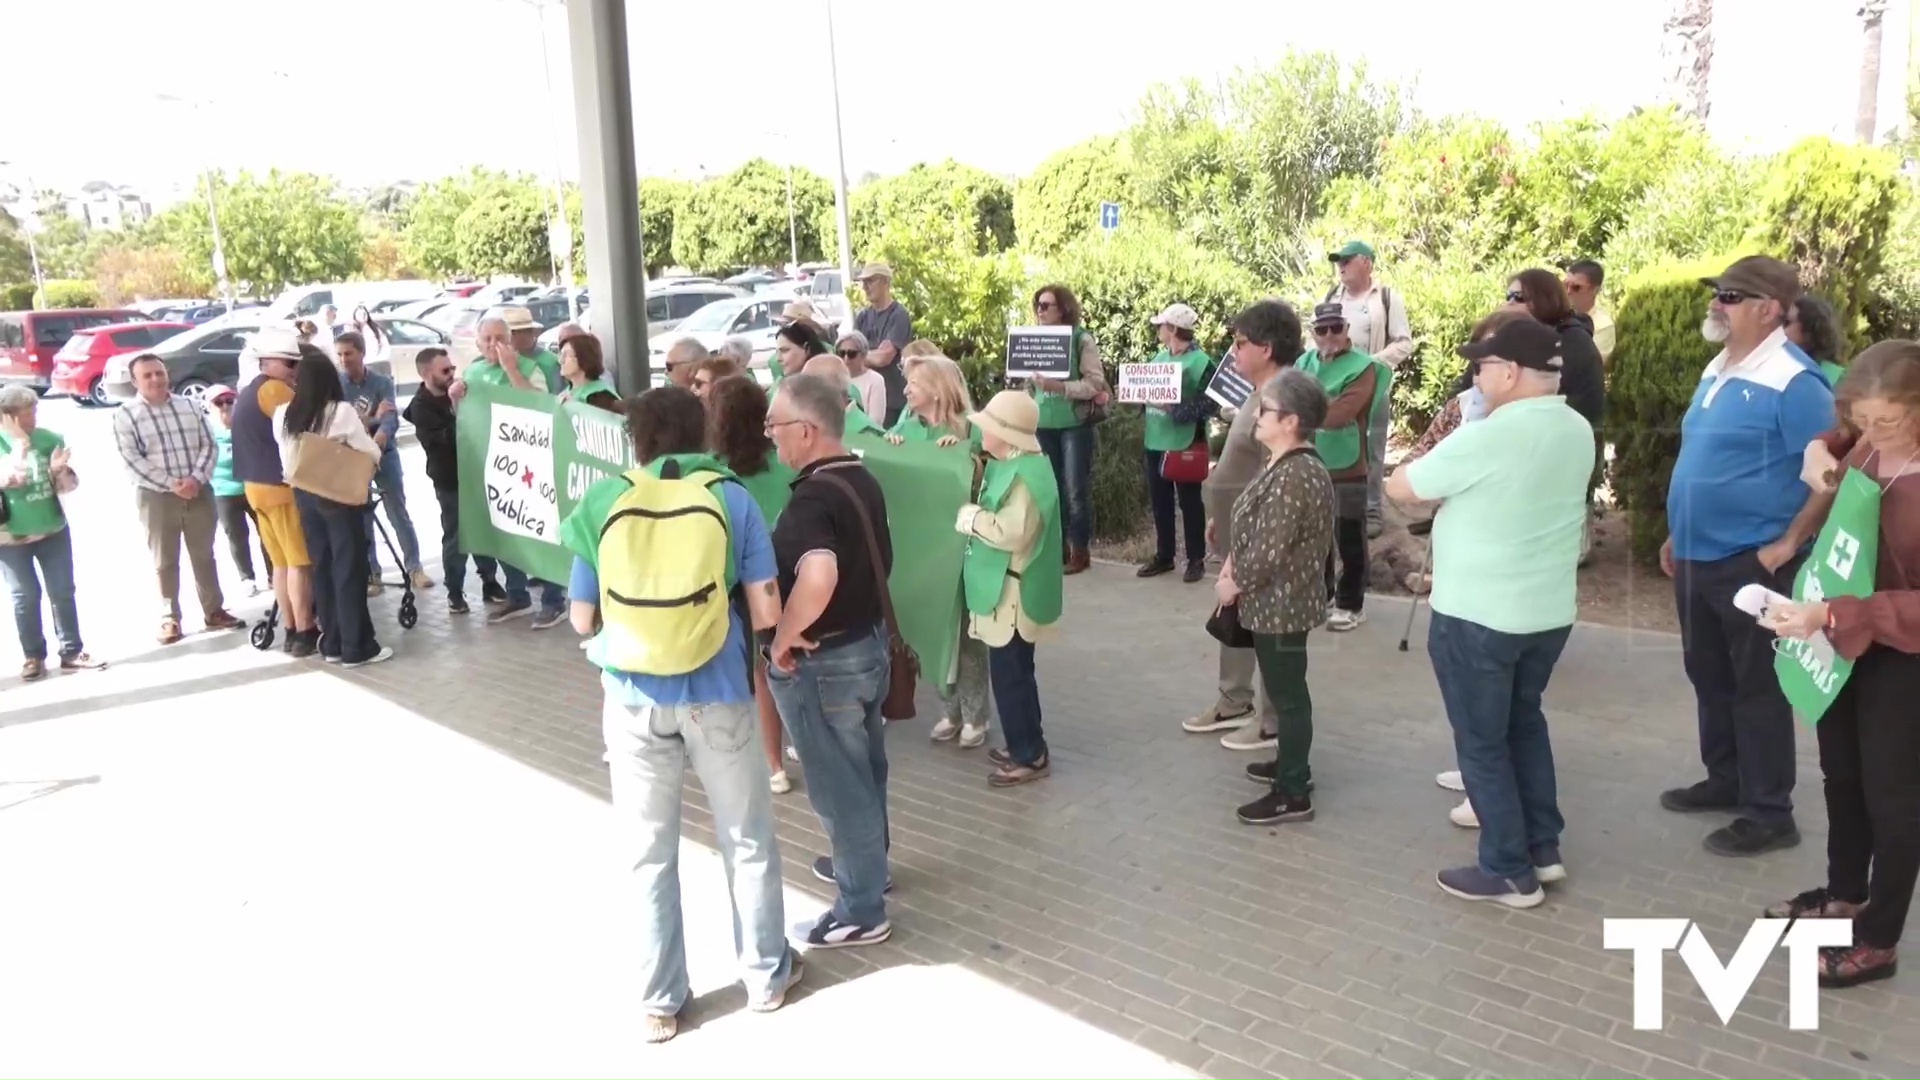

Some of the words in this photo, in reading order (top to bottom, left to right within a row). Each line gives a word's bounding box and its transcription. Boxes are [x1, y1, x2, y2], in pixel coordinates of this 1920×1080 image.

[1125, 364, 1175, 376] CONSULTAS
[1128, 377, 1171, 386] PRESENCIALES
[1121, 387, 1131, 400] 24
[1137, 387, 1147, 400] 48
[1148, 387, 1178, 400] HORAS
[572, 414, 623, 466] SANIDAD
[493, 454, 518, 476] 100
[539, 481, 556, 505] 100
[487, 484, 545, 536] Pública
